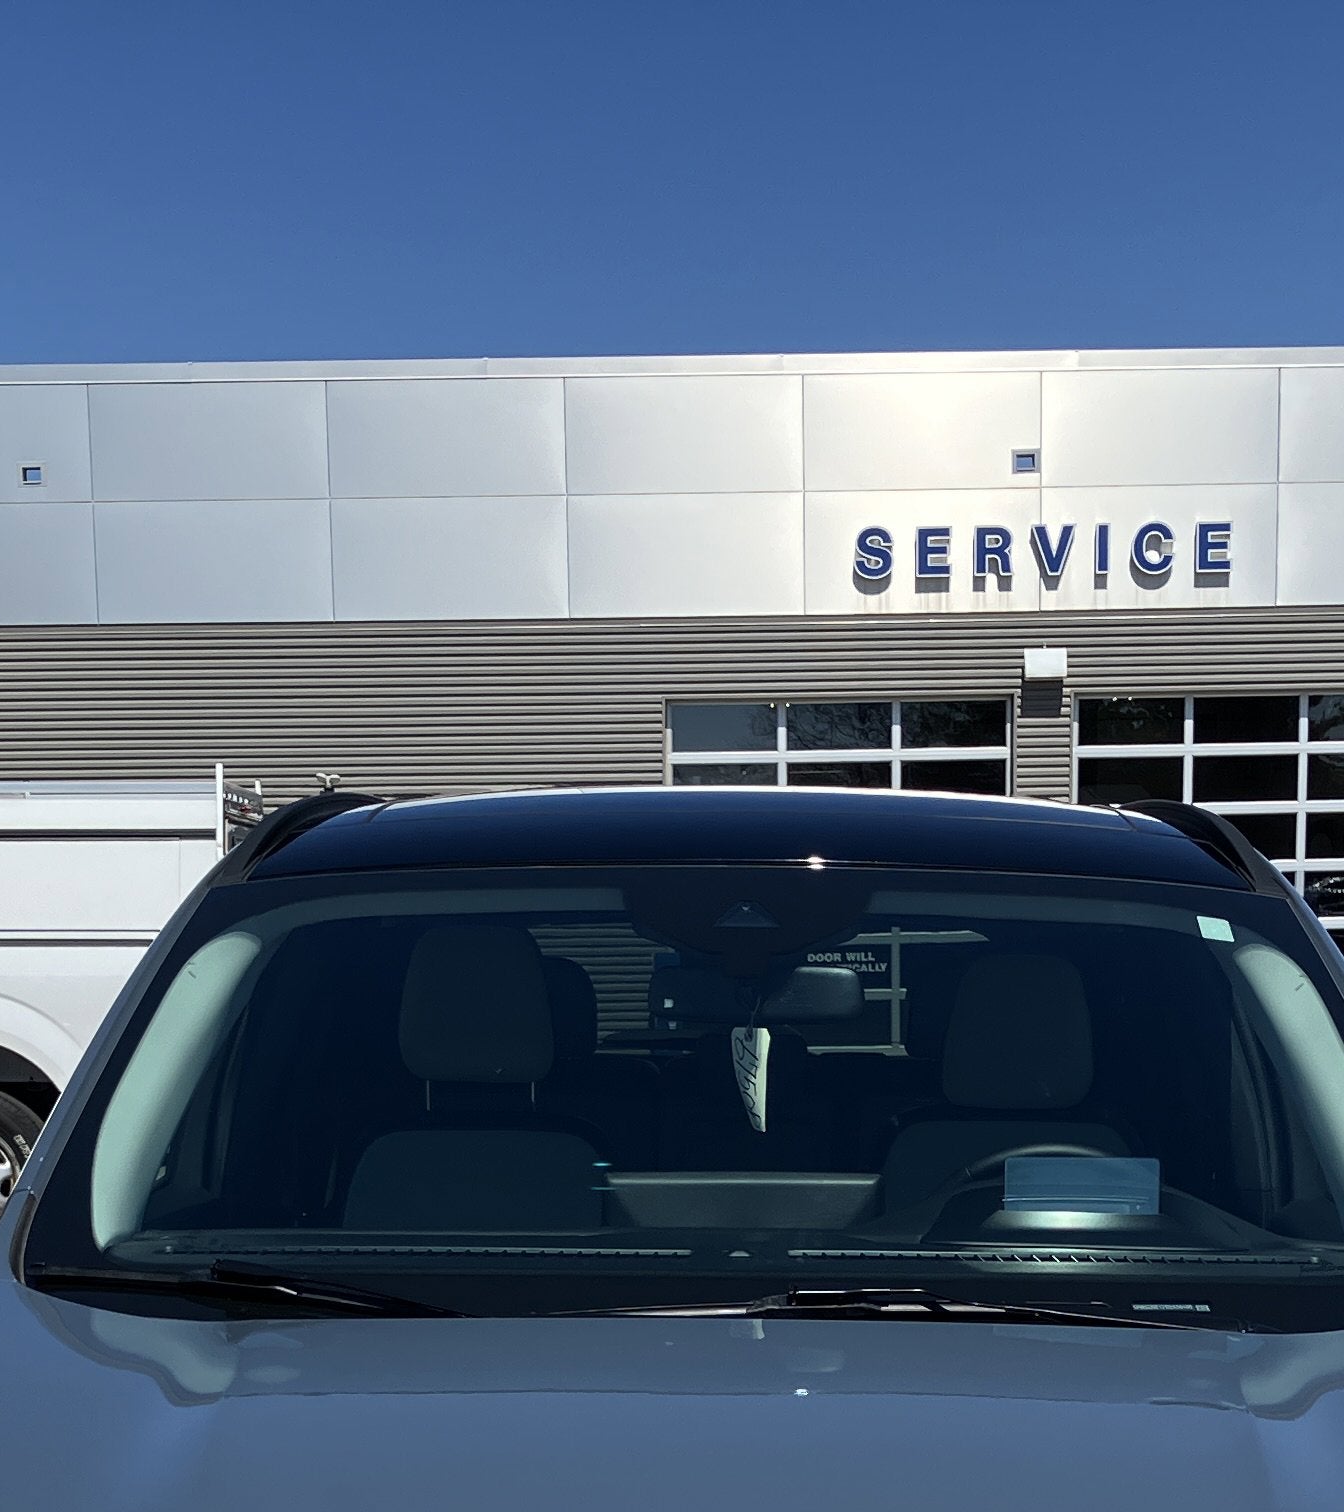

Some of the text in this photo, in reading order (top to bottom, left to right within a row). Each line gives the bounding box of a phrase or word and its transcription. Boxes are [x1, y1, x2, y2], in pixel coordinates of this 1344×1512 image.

[855, 520, 1234, 580] SERVICE
[807, 952, 875, 962] DOOR WILL
